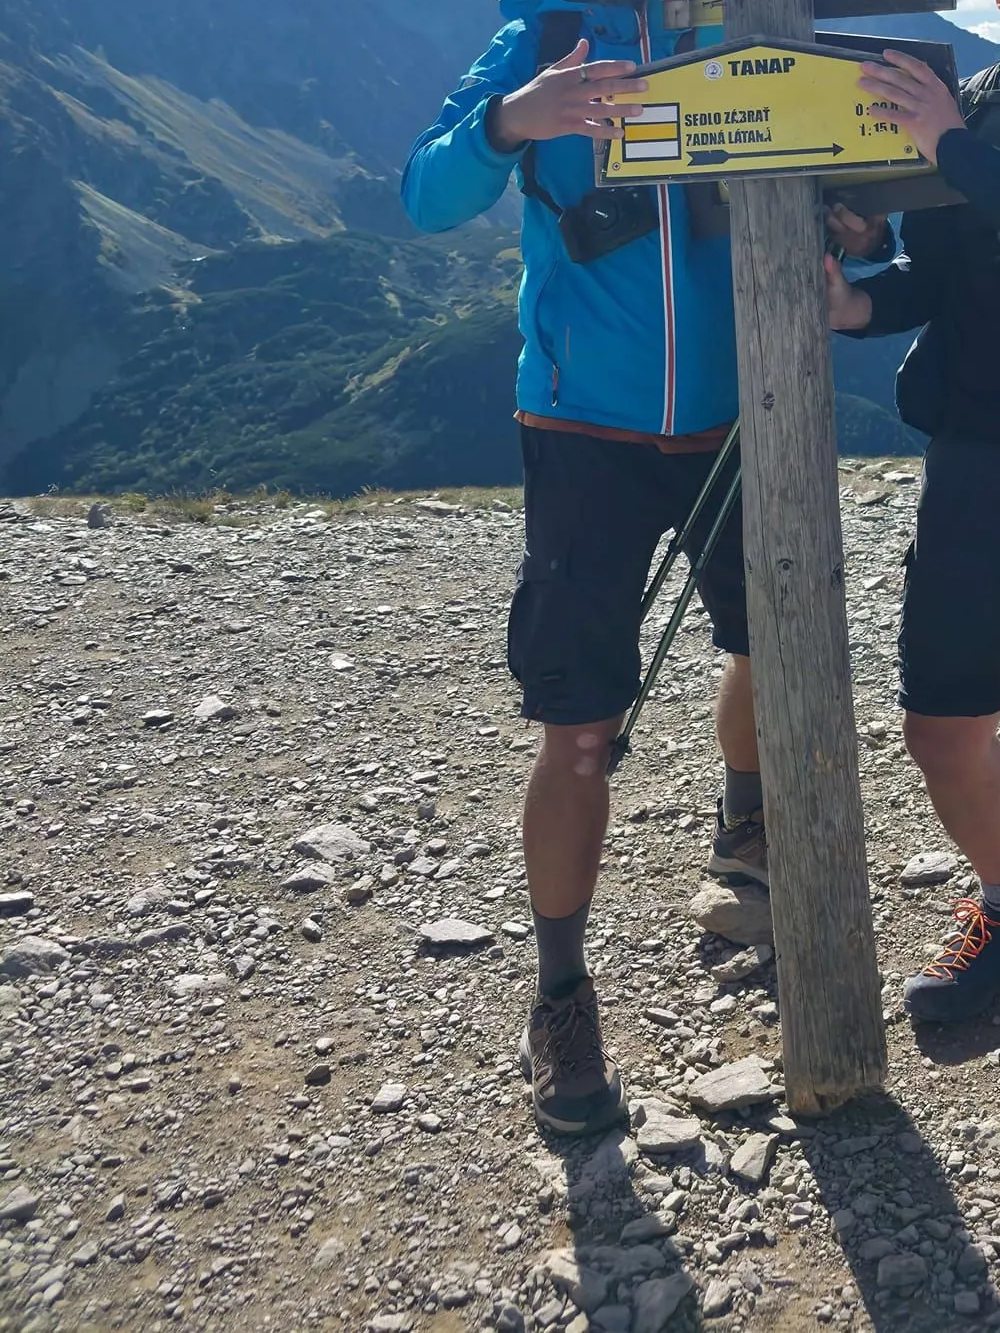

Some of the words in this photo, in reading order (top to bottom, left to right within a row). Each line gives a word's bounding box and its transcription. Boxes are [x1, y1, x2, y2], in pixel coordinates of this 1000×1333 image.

[728, 57, 796, 77] TANAP
[684, 112, 722, 127] SEDLO
[685, 129, 726, 147] ZADNÁ
